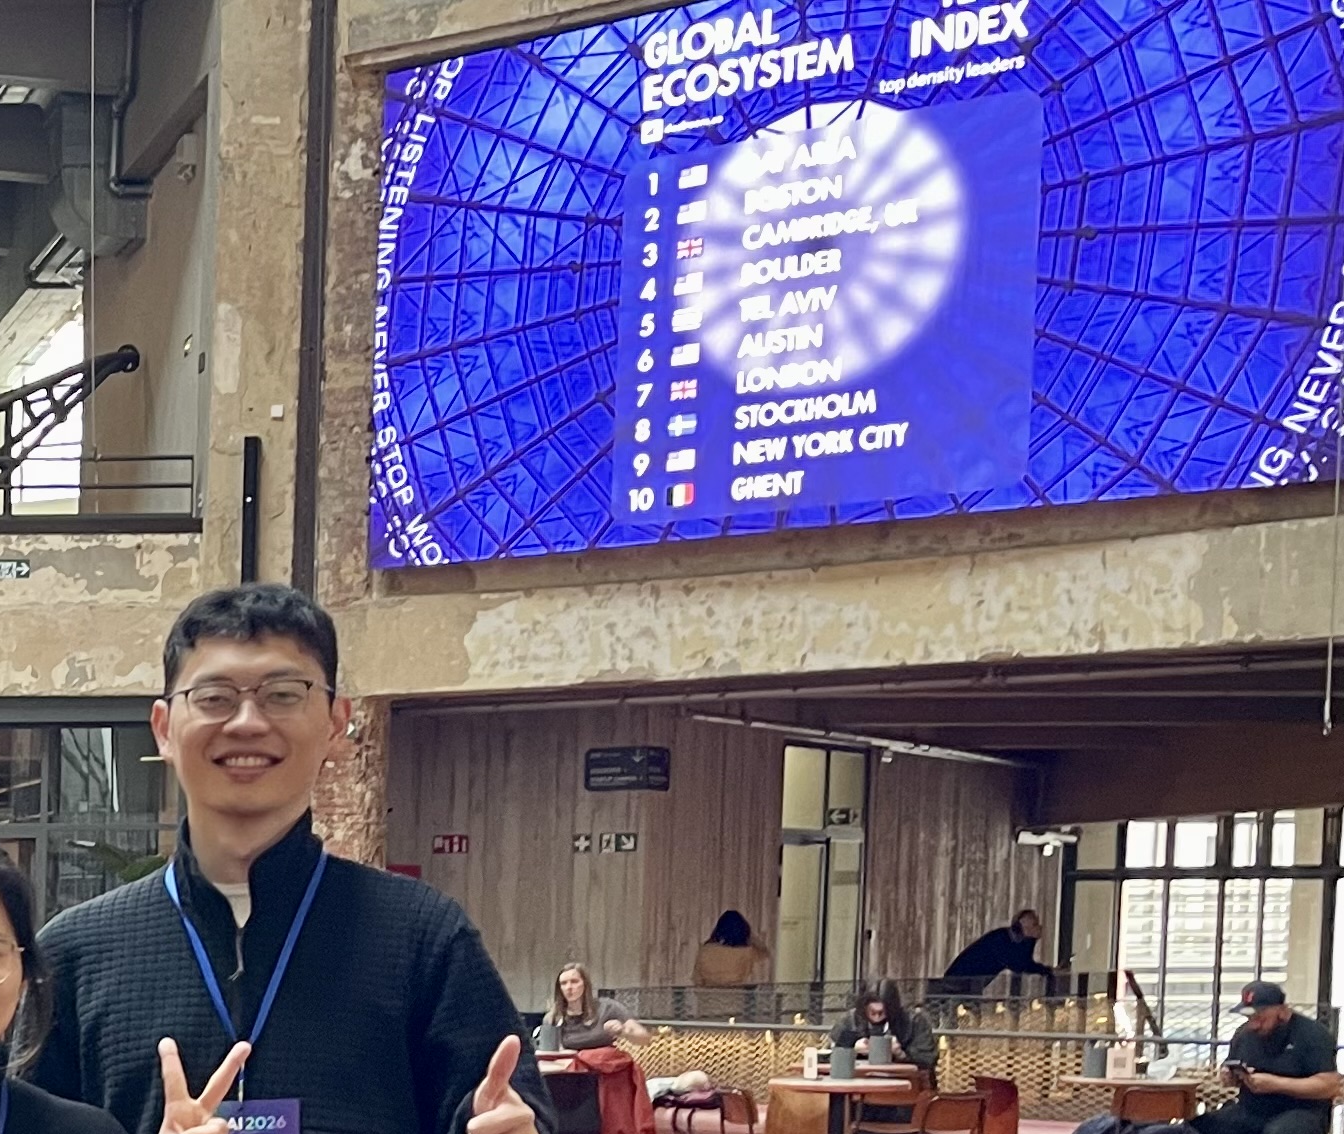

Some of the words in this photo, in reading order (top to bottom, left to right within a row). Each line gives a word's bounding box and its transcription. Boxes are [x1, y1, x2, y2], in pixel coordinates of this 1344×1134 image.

[644, 8, 780, 69] GLOBAL
[910, 0, 1029, 58] INDEX
[642, 33, 855, 112] ECOSYSTEM
[880, 76, 906, 94] top
[907, 65, 964, 88] density
[966, 55, 1025, 77] leaders
[376, 113, 436, 291] LISTENING
[644, 207, 659, 232] 2
[744, 175, 842, 214] BOSTON
[649, 172, 658, 195] 1
[642, 242, 658, 267] 3
[742, 205, 878, 250] CAMBRIDGE,
[640, 277, 656, 301] 4
[739, 249, 841, 287] BOULDER
[639, 313, 655, 338] 5
[739, 294, 775, 322] TEL
[778, 285, 838, 316] AVIV
[637, 348, 654, 372] 6
[737, 323, 823, 358] AUSTIN
[636, 383, 653, 407] 7
[736, 356, 842, 394] LONDON
[635, 418, 650, 442] 8
[734, 389, 876, 430] STOCKHOLM
[376, 425, 414, 507] STOP
[633, 453, 650, 477] 9
[732, 436, 787, 466] NEW
[792, 429, 853, 458] YORK
[859, 422, 909, 451] CITY
[629, 487, 654, 512] 10
[731, 470, 804, 502] GHENT
[404, 513, 450, 566] WO
[245, 1115, 286, 1130] 2026
